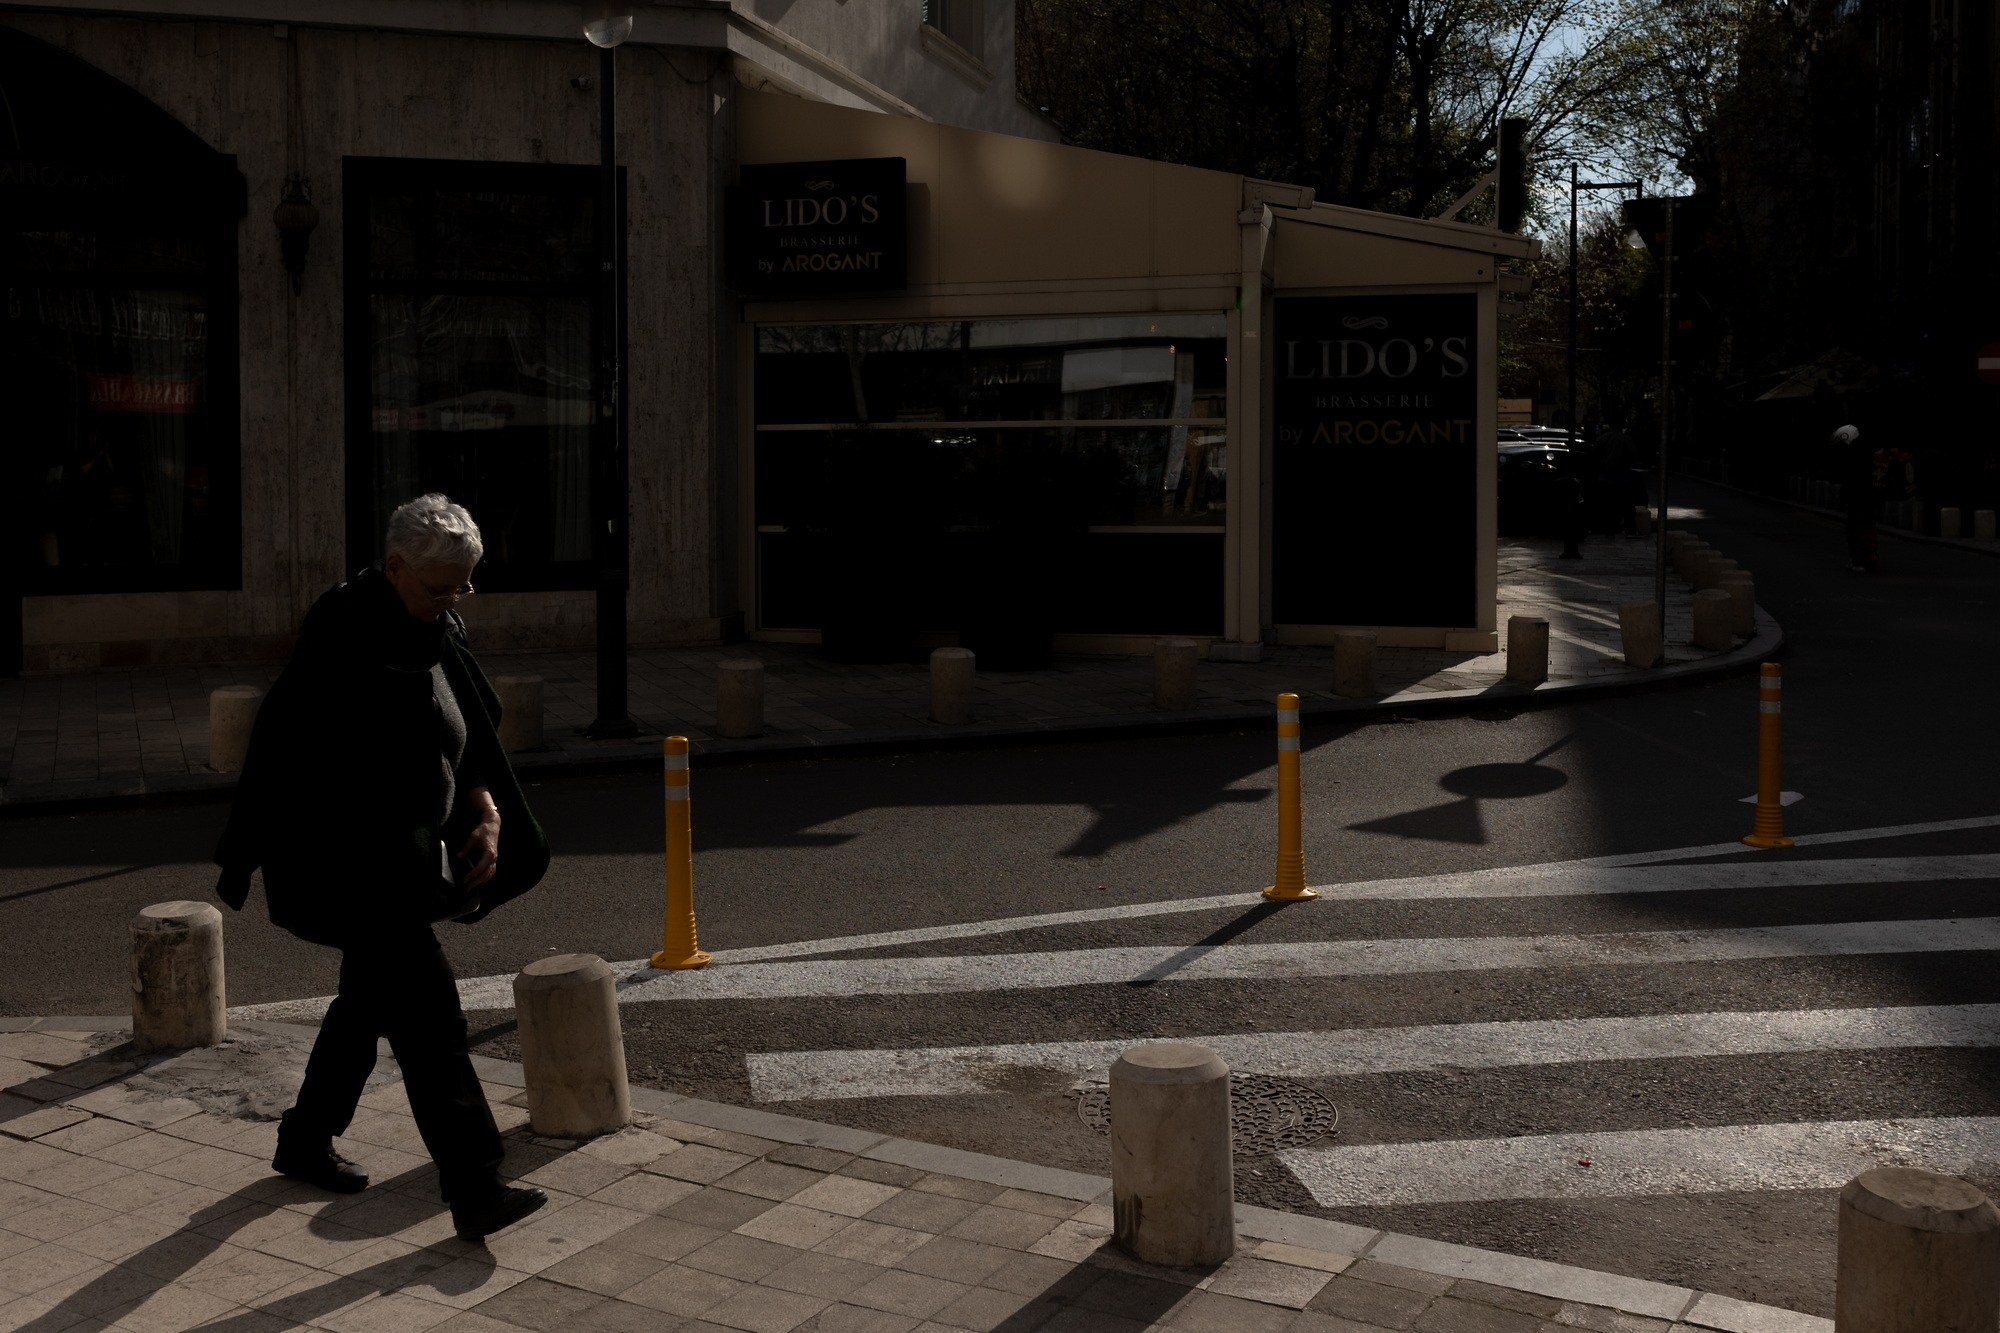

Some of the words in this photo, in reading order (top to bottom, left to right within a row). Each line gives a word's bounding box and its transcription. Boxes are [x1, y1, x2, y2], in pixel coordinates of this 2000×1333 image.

[761, 194, 880, 228] LIDO'S
[779, 235, 861, 249] BRASSERIE
[757, 257, 775, 273] by
[781, 251, 883, 273] AROGANT
[1281, 336, 1470, 380] LIDO'S
[1315, 393, 1435, 409] BRASSERIE
[1279, 424, 1304, 447] by
[1311, 418, 1473, 446] AROGANT
